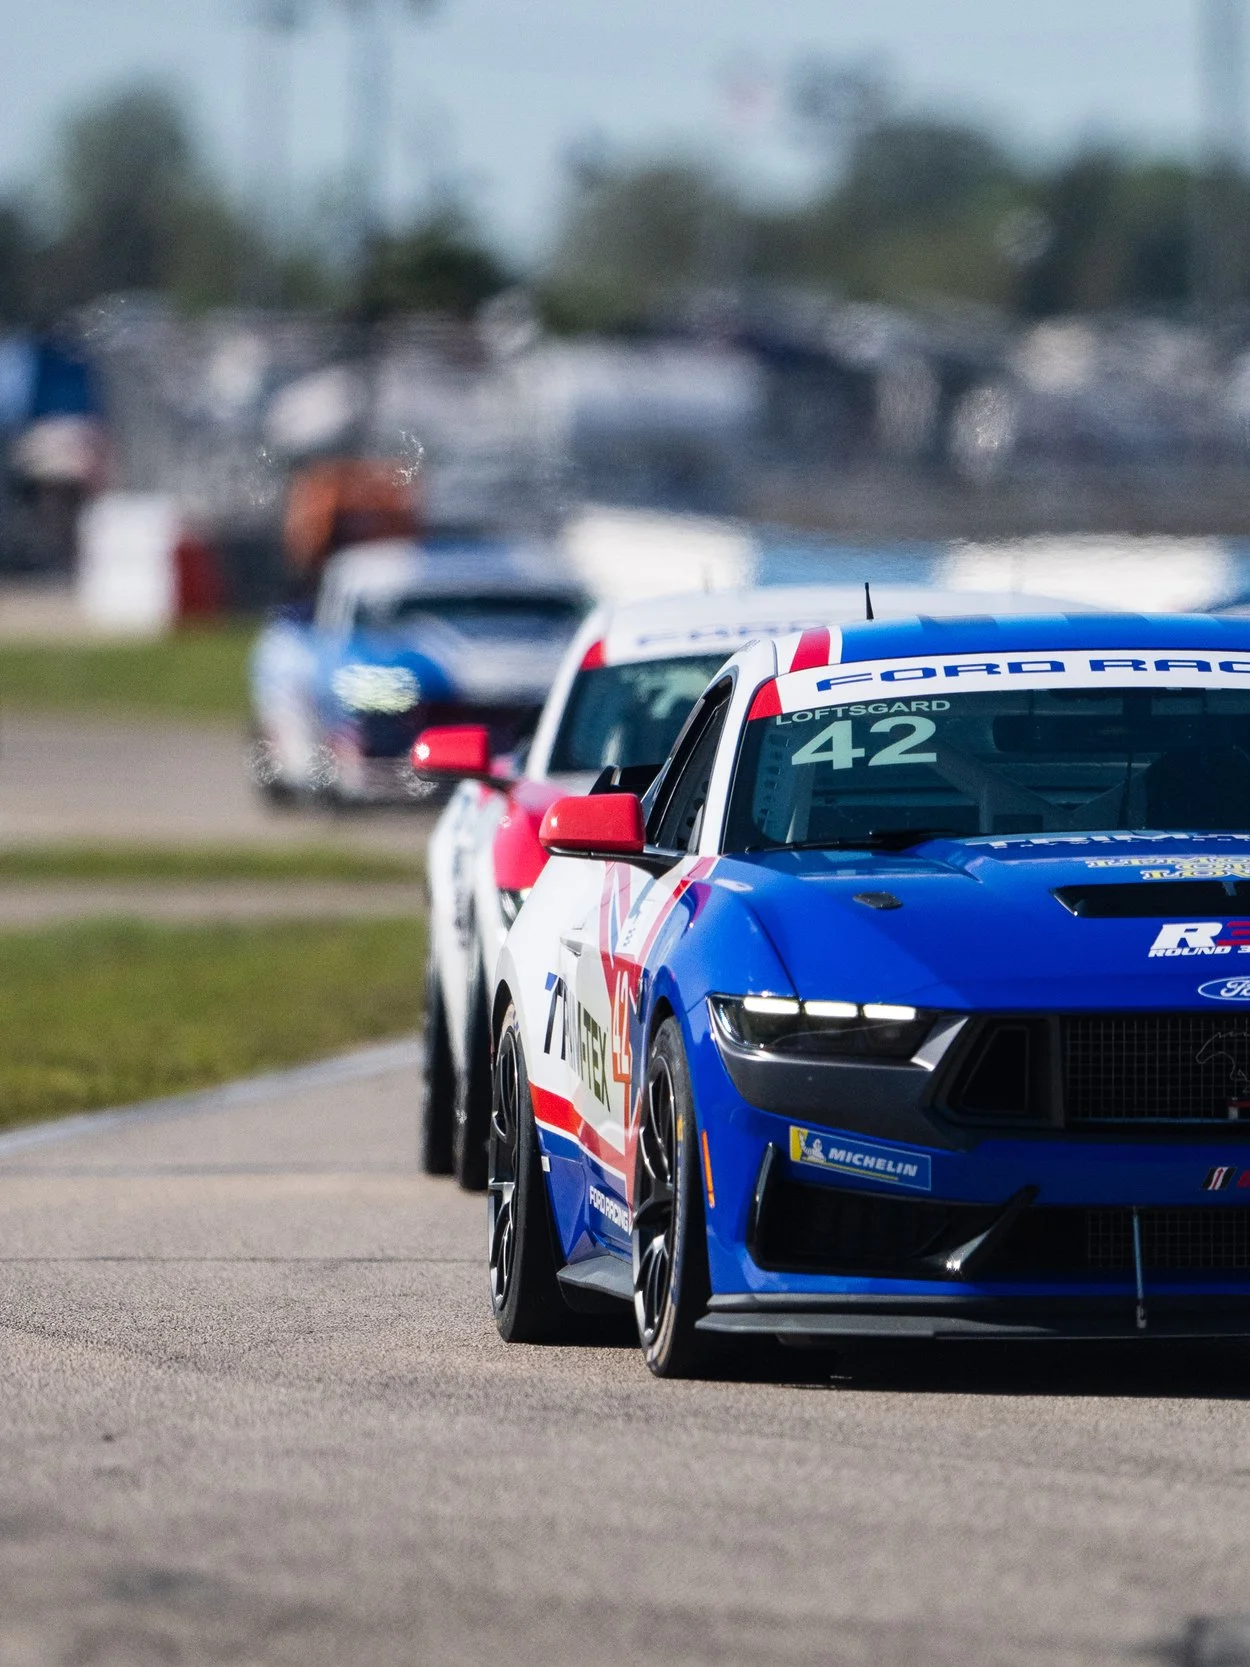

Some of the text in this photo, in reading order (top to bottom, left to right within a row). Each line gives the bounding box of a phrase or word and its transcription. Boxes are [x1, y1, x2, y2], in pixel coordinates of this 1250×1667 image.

[816, 660, 1066, 692] FORD
[775, 700, 951, 726] LOFTSGARD
[791, 715, 938, 771] 42
[1148, 945, 1232, 957] ROUND
[828, 1147, 919, 1177] MICHELIN
